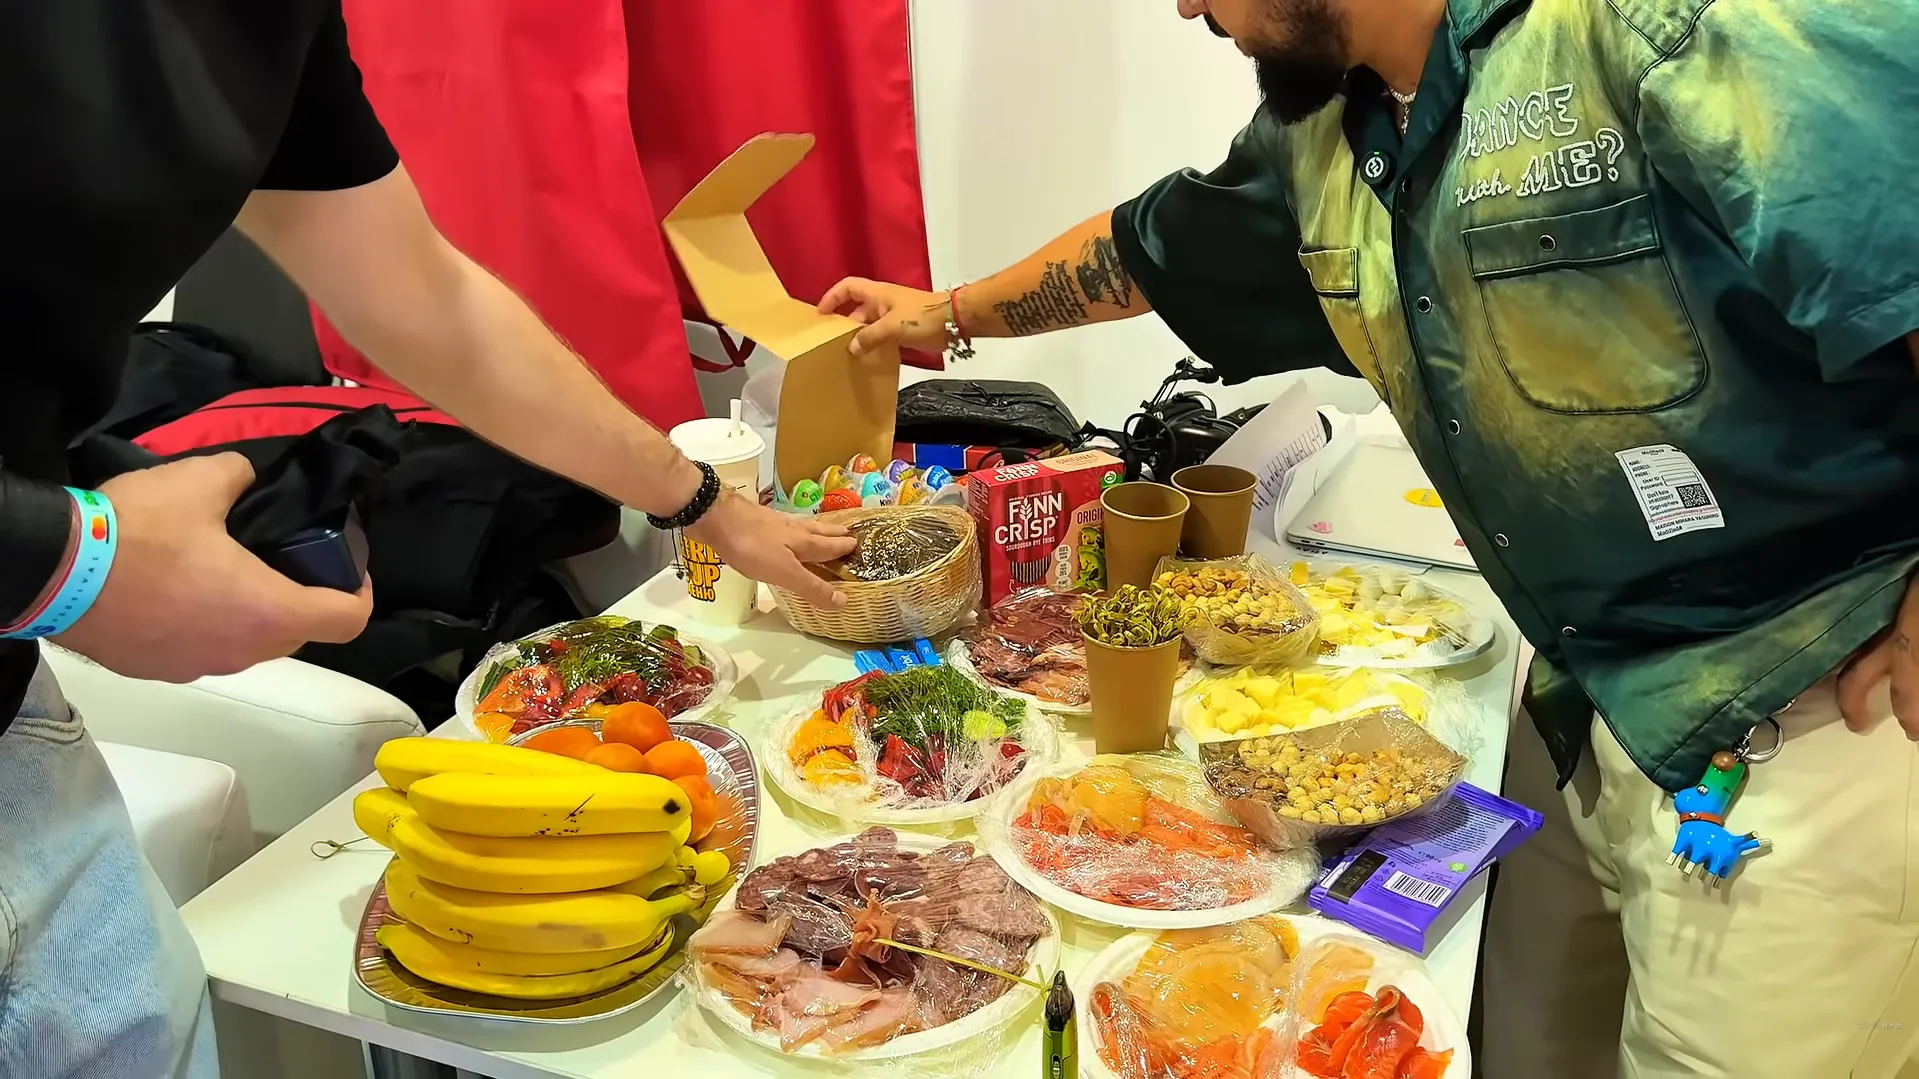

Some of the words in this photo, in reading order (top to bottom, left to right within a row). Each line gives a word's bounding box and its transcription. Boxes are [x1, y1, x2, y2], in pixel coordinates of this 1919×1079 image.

[1516, 128, 1624, 197] ME?
[995, 469, 1039, 482] CRISP
[994, 516, 1058, 544] CRISP
